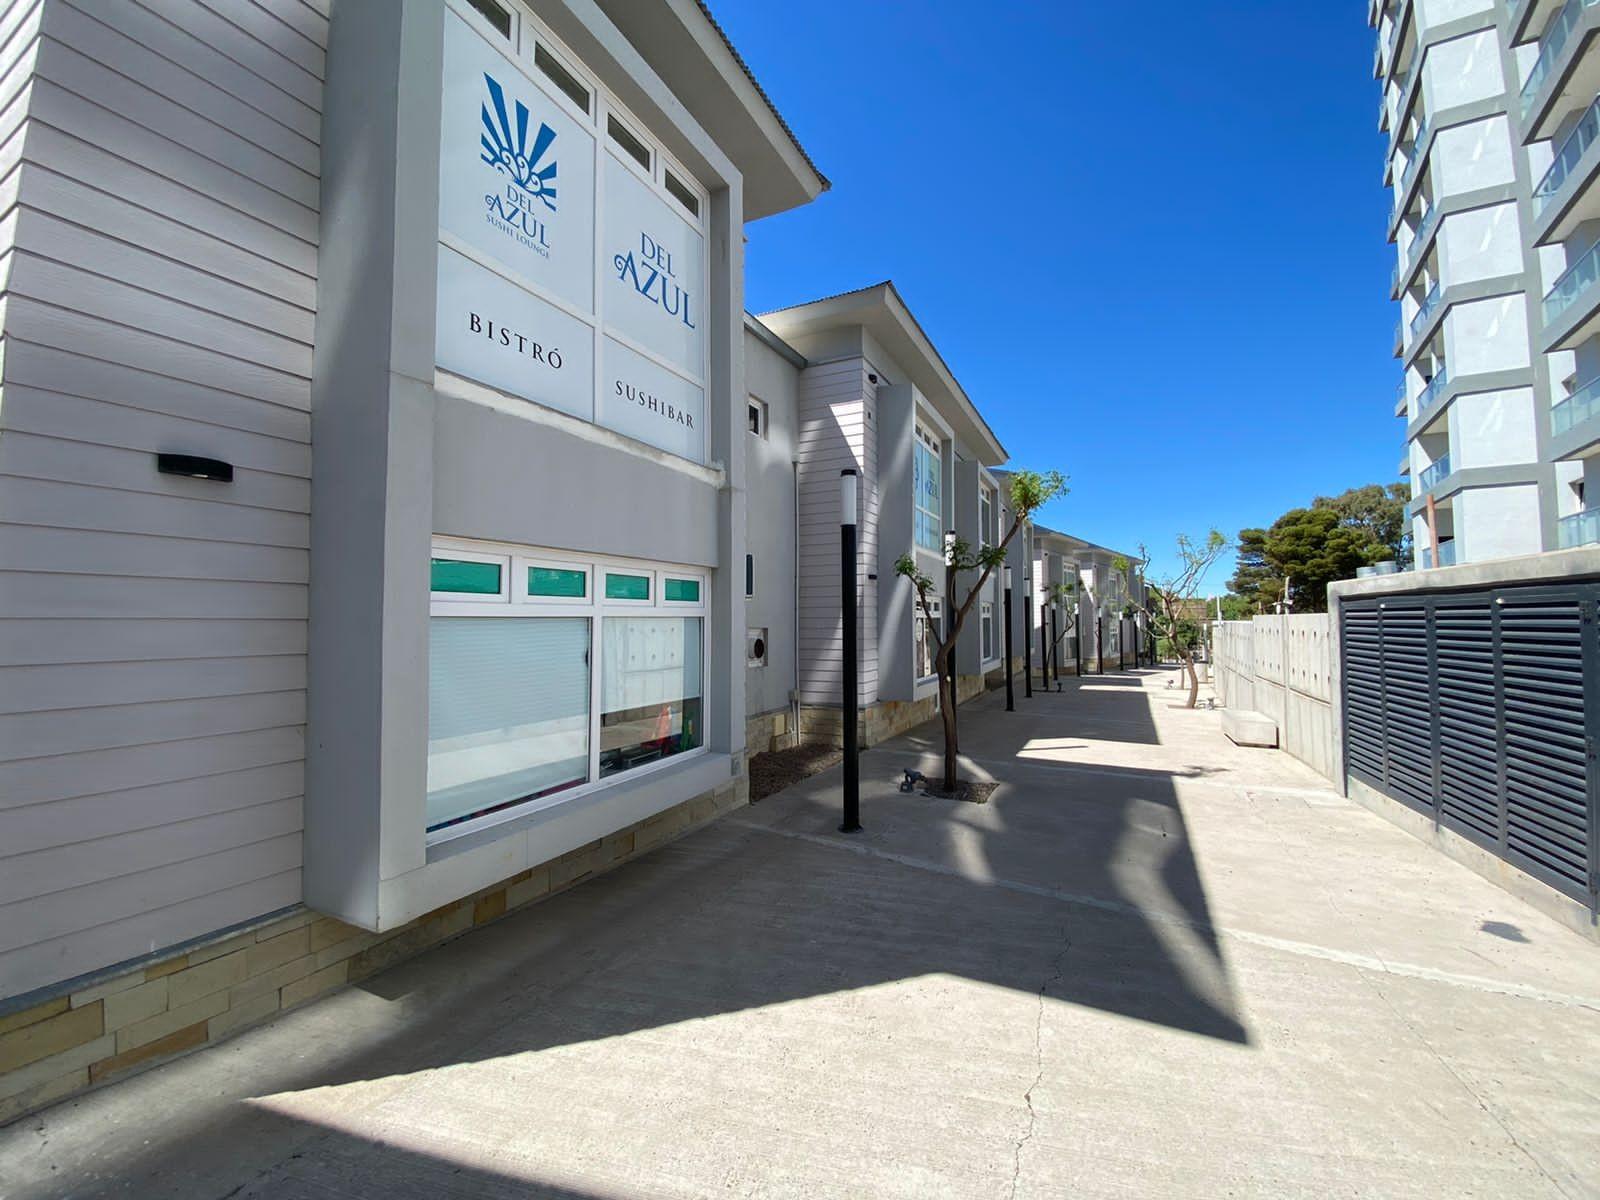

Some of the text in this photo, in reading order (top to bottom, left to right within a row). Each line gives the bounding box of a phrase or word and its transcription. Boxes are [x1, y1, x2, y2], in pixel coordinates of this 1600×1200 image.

[484, 193, 550, 249] AZUL
[507, 184, 535, 216] DEL
[486, 213, 550, 259] SUSHI LOUNGE
[641, 231, 676, 278] DEL
[614, 250, 696, 329] AZUL
[469, 312, 563, 369] BISTRÓ
[615, 380, 694, 430] SUSHIBAR
